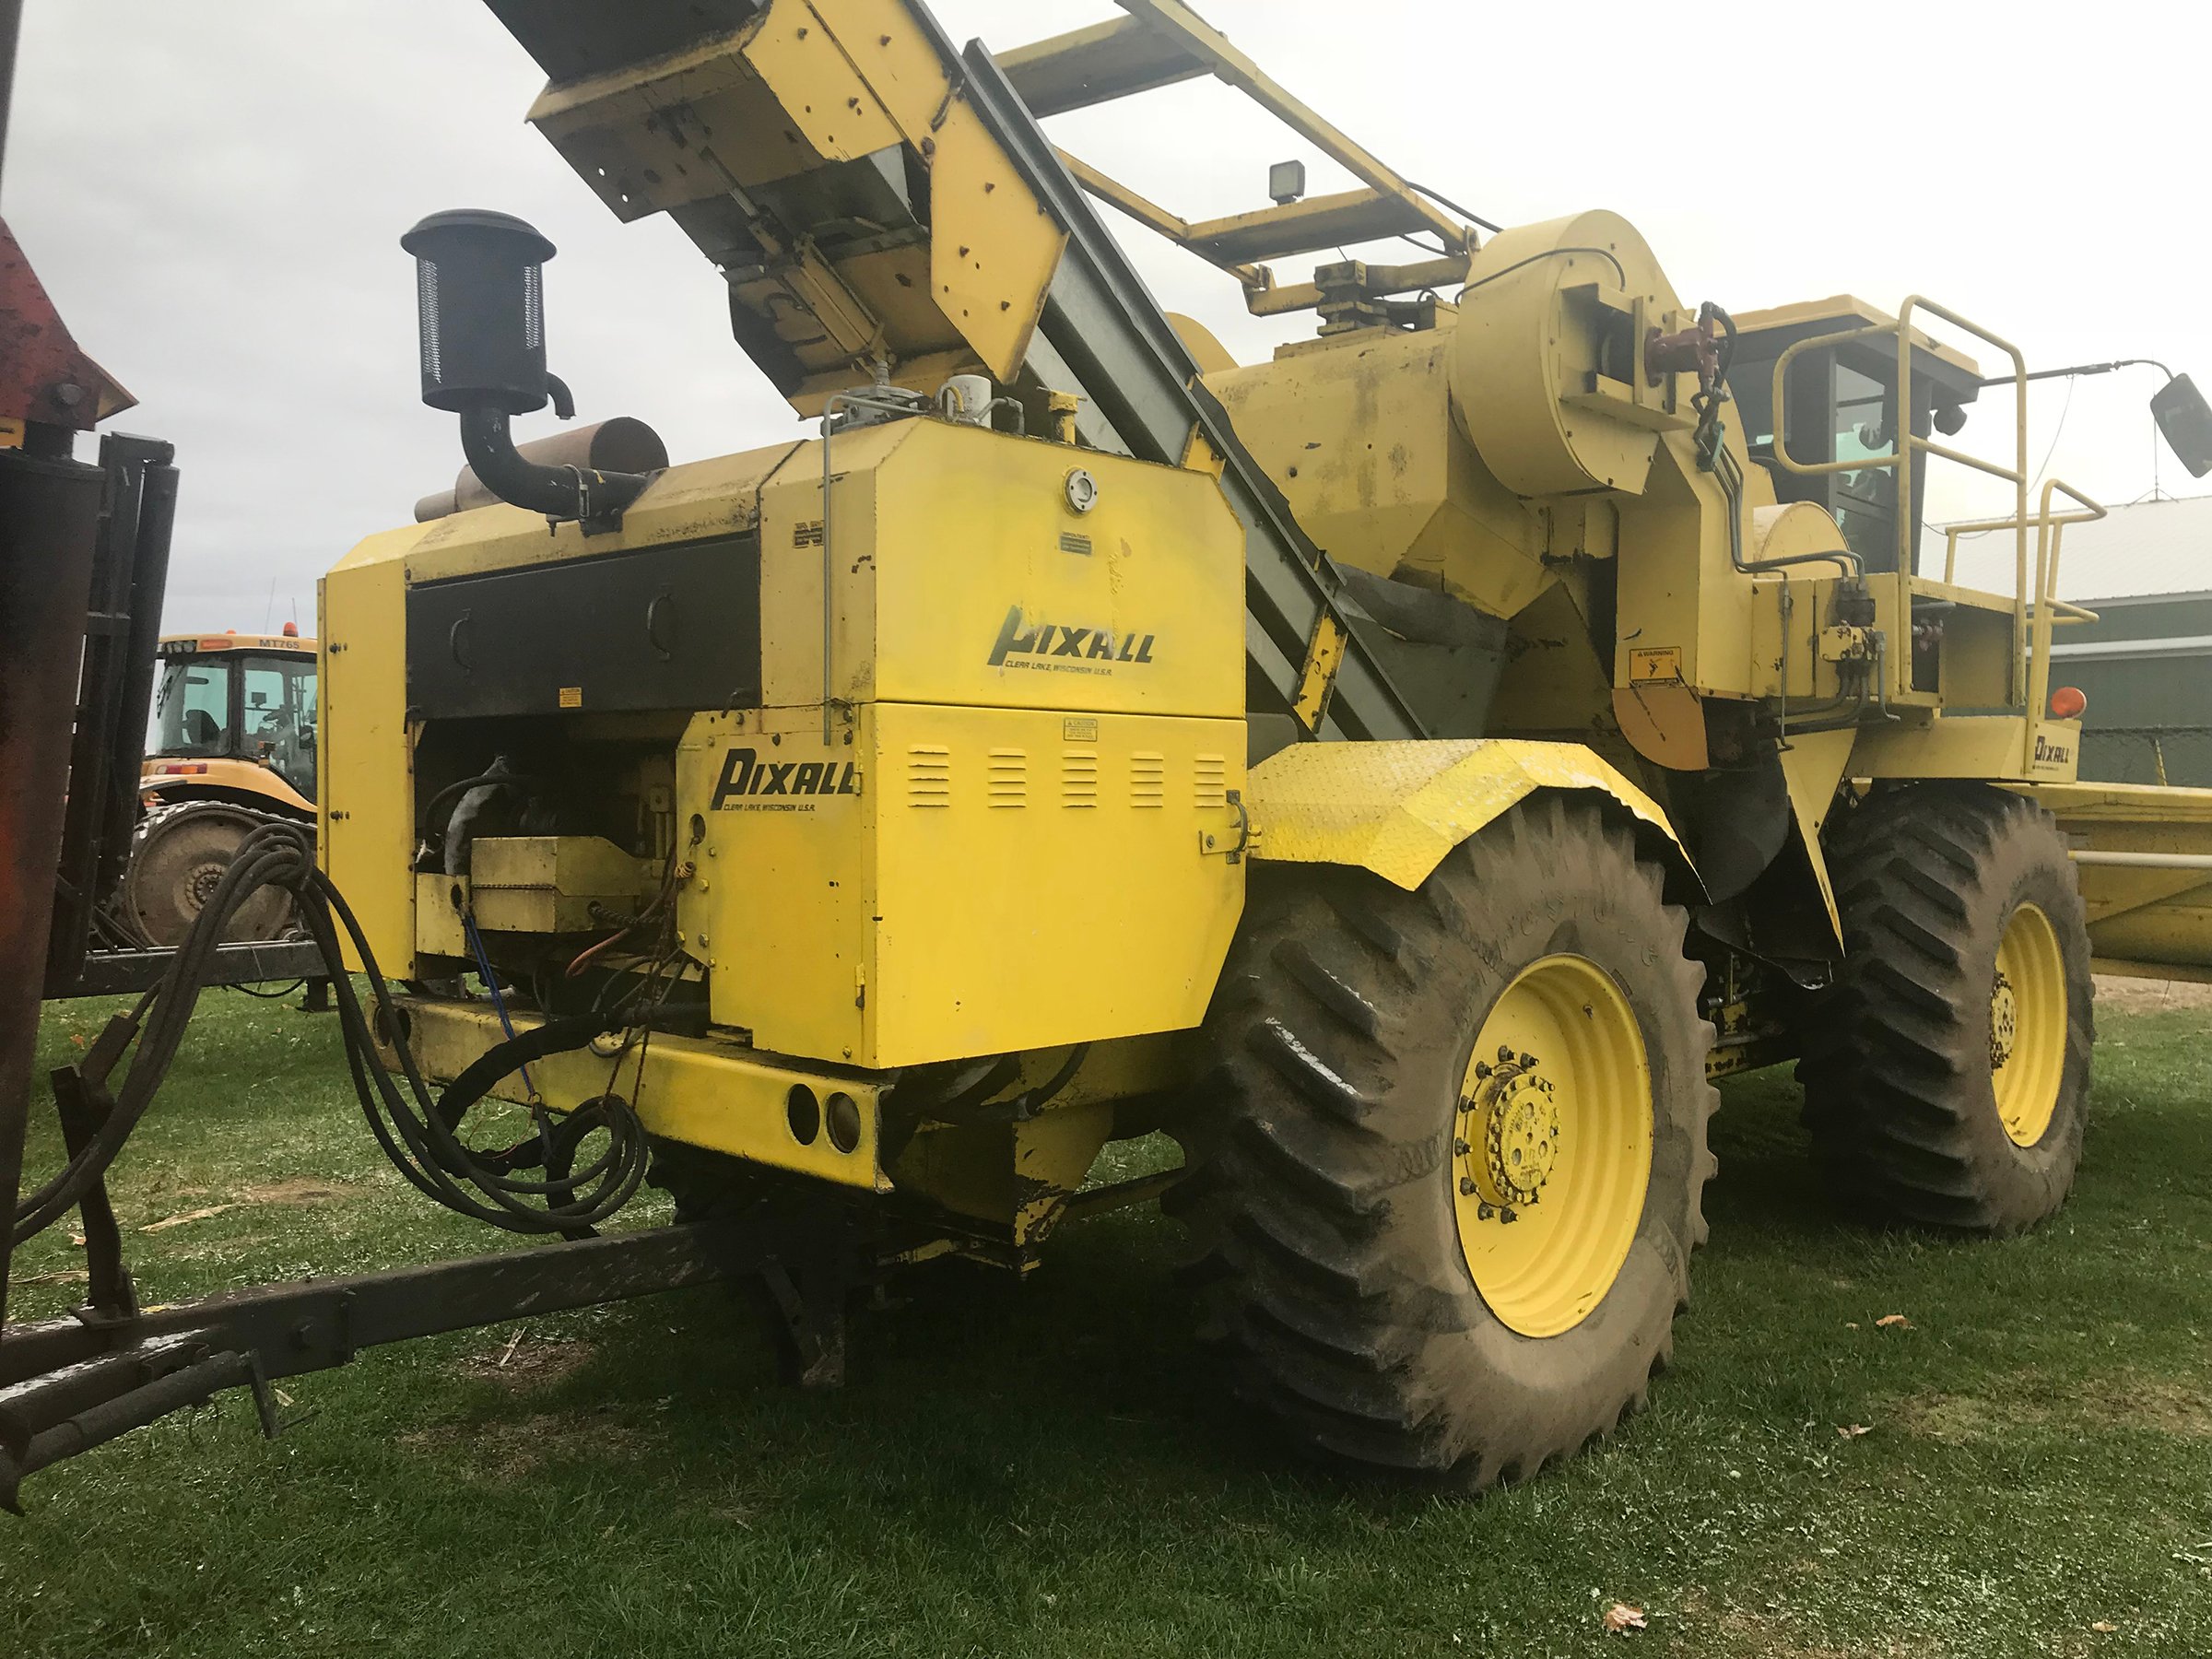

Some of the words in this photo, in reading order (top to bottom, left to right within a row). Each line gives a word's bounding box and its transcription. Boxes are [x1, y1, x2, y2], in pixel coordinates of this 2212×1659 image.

[259, 639, 300, 650] MT765
[986, 605, 1155, 667] PIXALL
[1005, 660, 1030, 670] CLEAR
[1031, 663, 1052, 673] LAKE,
[1053, 665, 1093, 676] WISCONSIN
[2034, 735, 2070, 764] PIXALL
[710, 747, 854, 811] PIXALL
[724, 804, 743, 812] CLEAR
[761, 804, 796, 812] WISCONSIN
